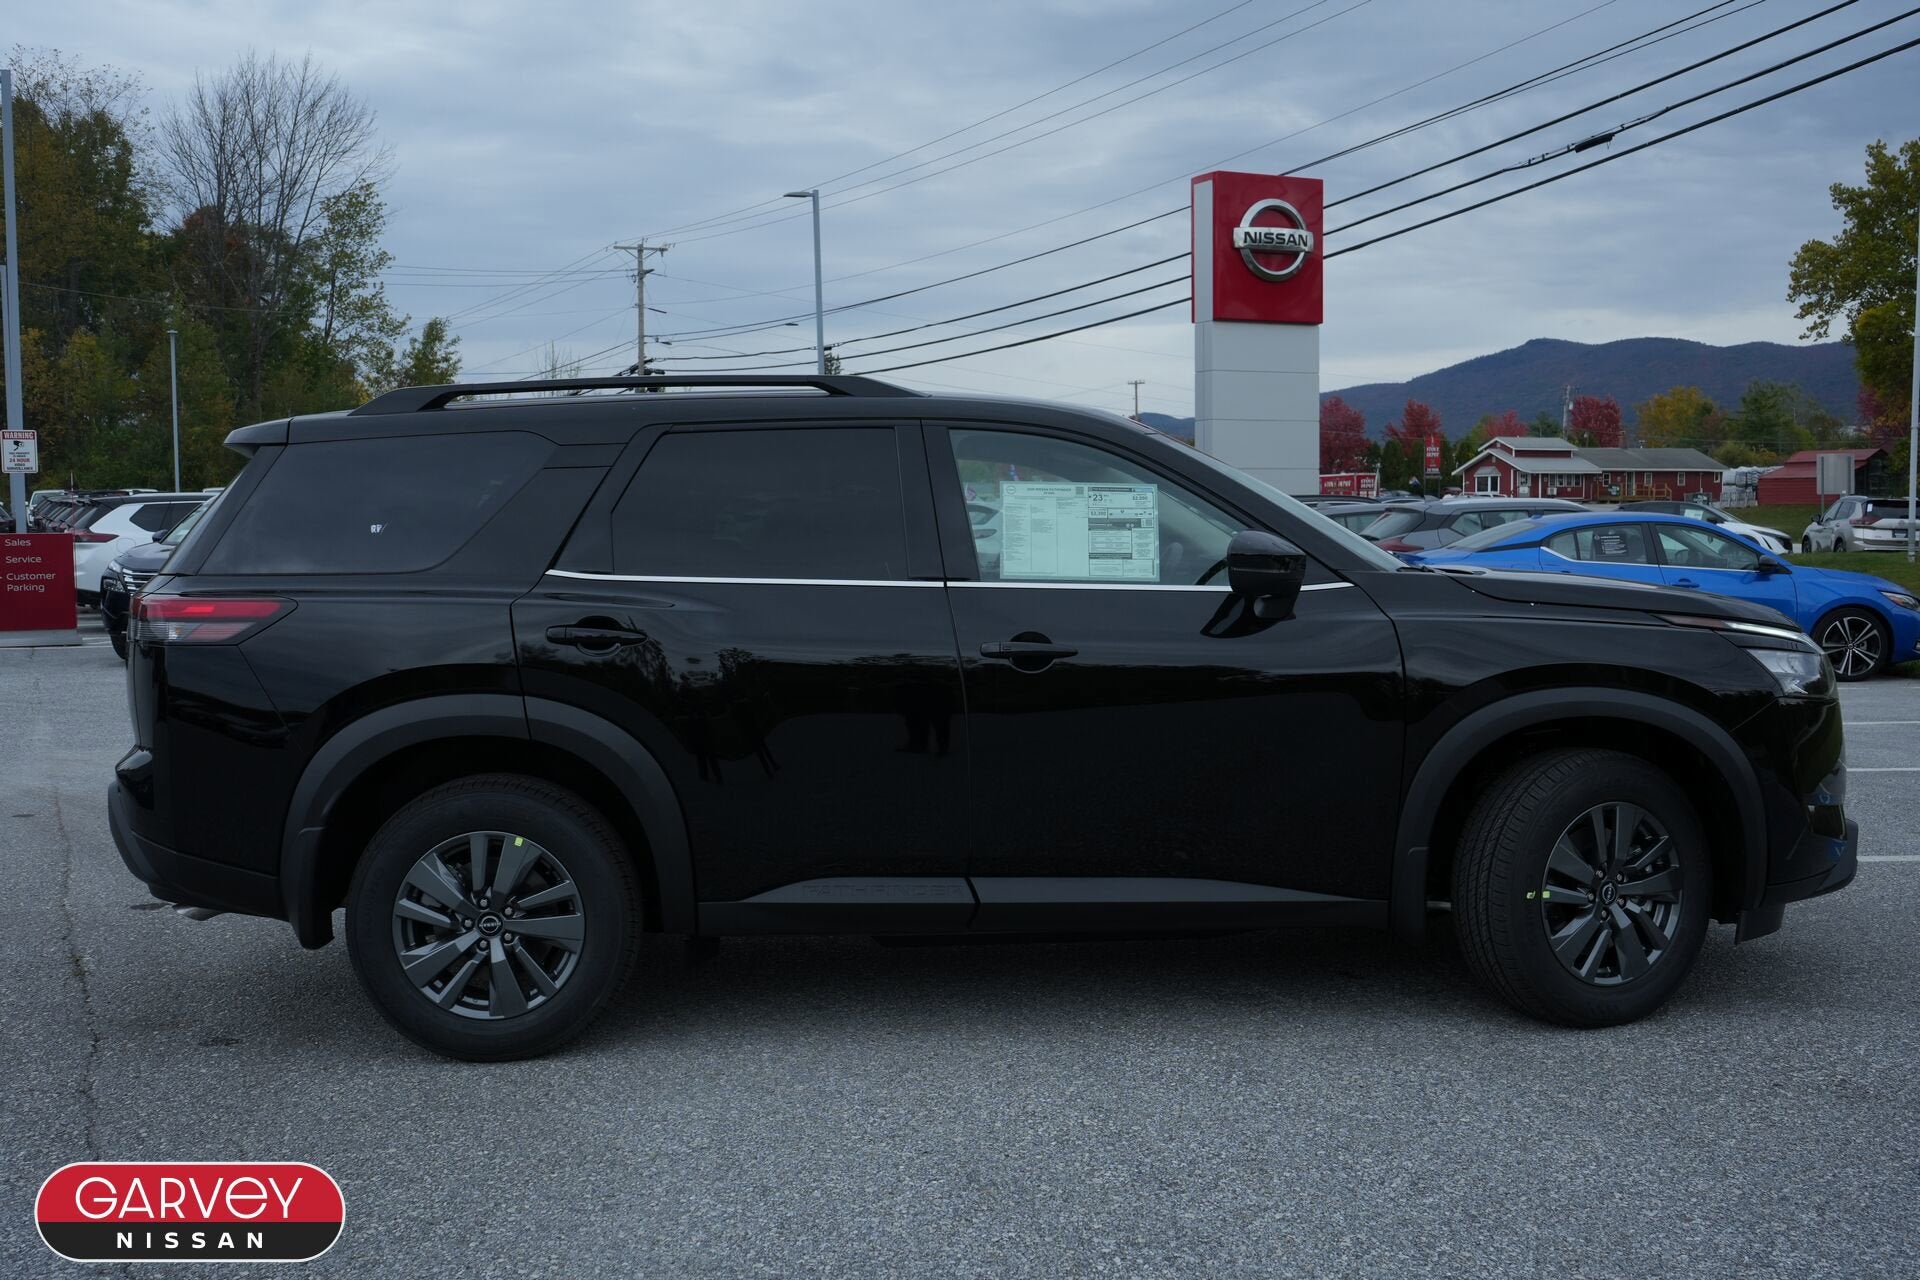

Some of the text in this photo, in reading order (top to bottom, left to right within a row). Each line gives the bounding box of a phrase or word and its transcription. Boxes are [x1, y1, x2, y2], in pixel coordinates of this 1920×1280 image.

[1243, 231, 1308, 247] NISSAN
[4, 431, 34, 439] WARNING
[1092, 494, 1103, 502] 23
[4, 538, 32, 547] Sales
[5, 555, 42, 564] Service
[6, 573, 56, 581] Customer
[7, 584, 45, 593] Parking
[801, 884, 963, 897] PATHFINDER
